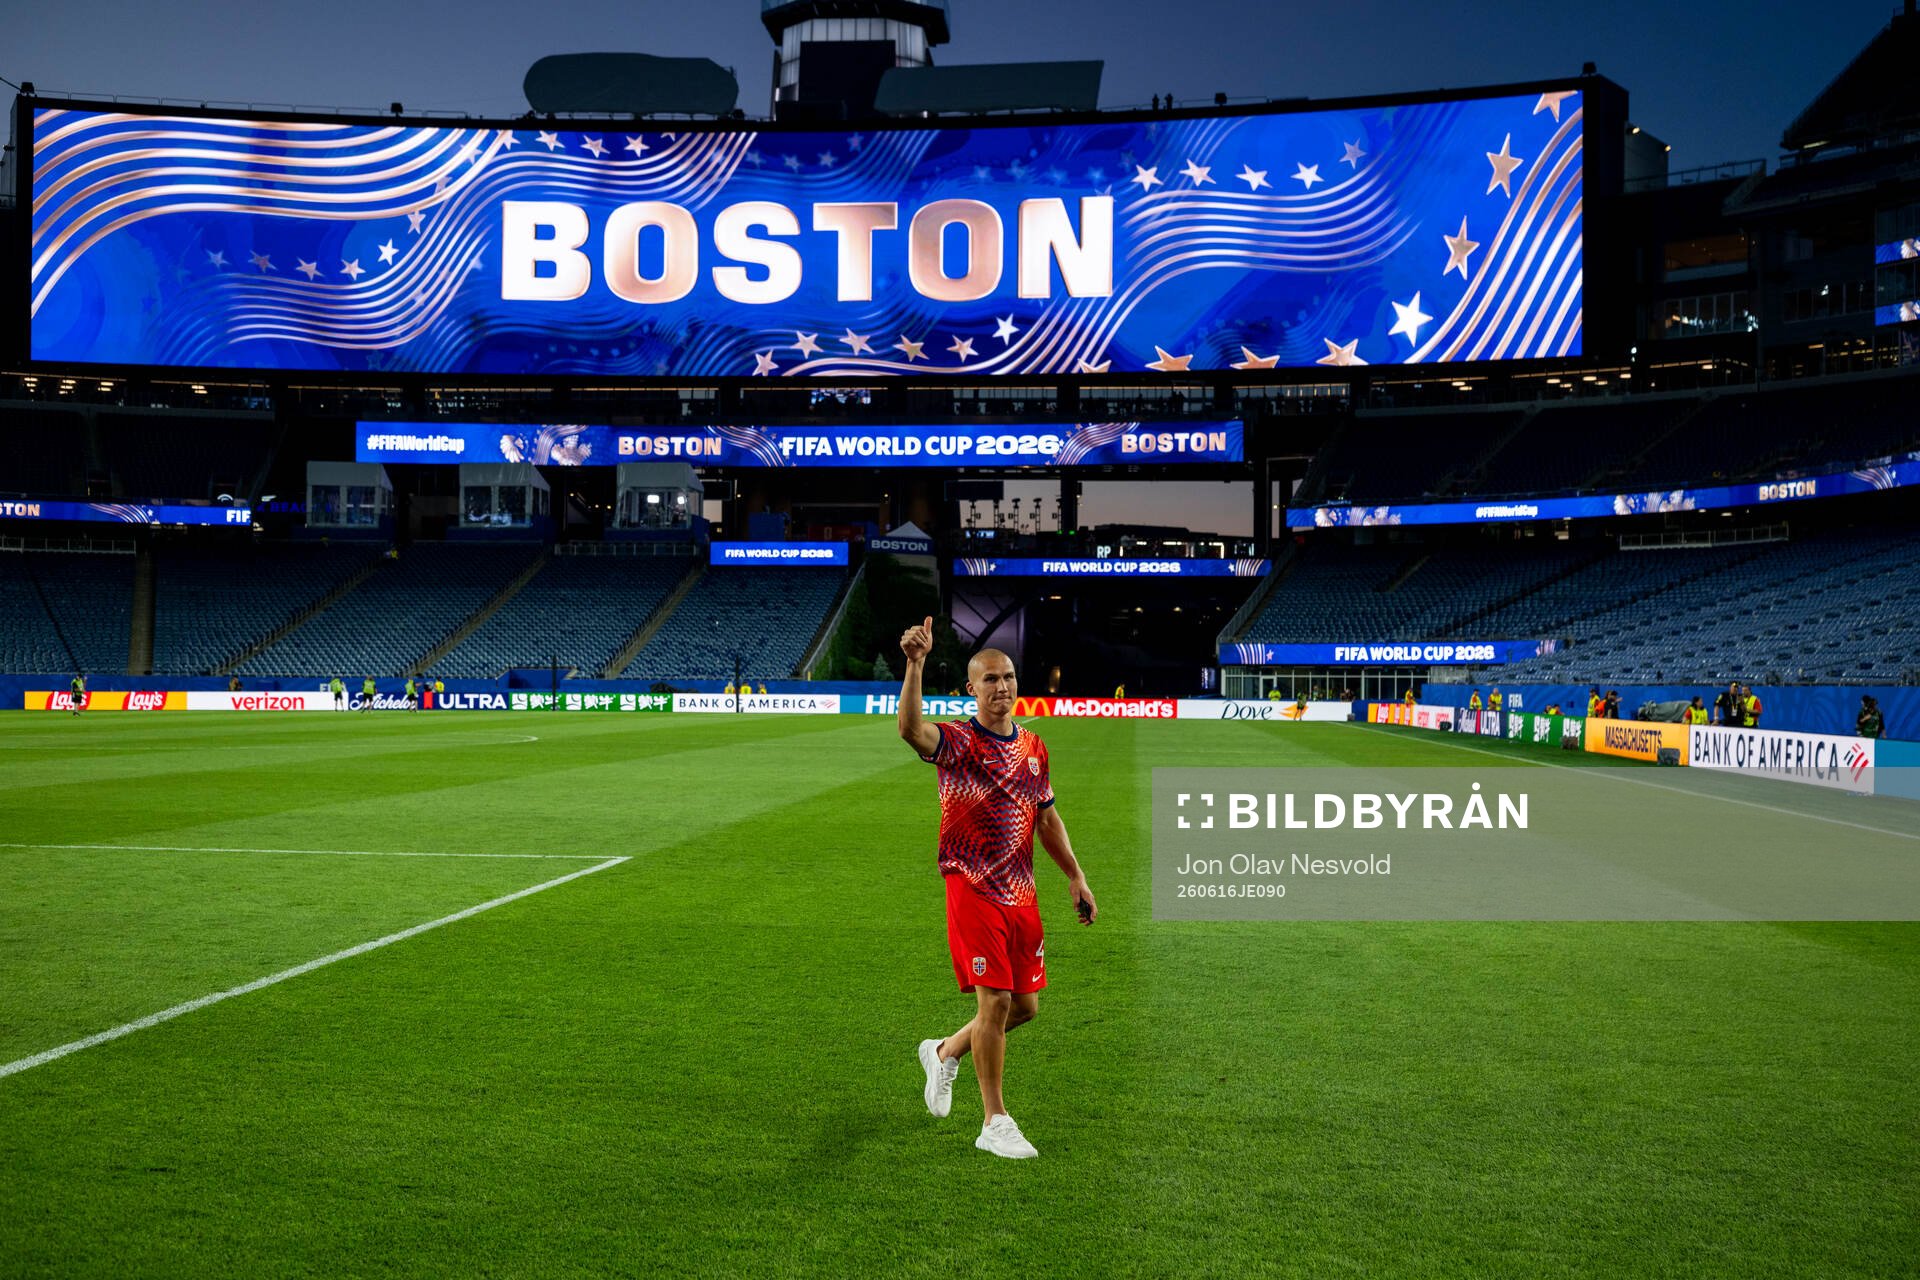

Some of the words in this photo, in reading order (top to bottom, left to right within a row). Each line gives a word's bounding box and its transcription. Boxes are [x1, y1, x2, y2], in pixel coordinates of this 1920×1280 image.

[501, 196, 1114, 303] BOSTON
[367, 434, 465, 454] #FIFAWorldCup
[618, 436, 722, 456] BOSTON
[782, 436, 836, 456] FIFA
[836, 436, 923, 456] WORLD
[925, 436, 972, 455] CUP
[975, 435, 1061, 455] 2026
[1121, 432, 1226, 453] BOSTON
[1759, 480, 1816, 500] BOSTON
[725, 549, 745, 558] FIFA
[746, 549, 780, 558] WORLD
[781, 549, 800, 558] CUP
[800, 549, 833, 558] 2026
[871, 539, 928, 551] BOSTON
[1042, 561, 1068, 573] FIFA
[1069, 561, 1111, 573] WORLD
[1113, 561, 1137, 573] CUP
[1138, 561, 1181, 573] 2026
[1335, 646, 1368, 661] FIFA
[1369, 646, 1421, 661] WORLD
[1423, 646, 1453, 660] CUP
[128, 691, 163, 710] Lay's
[231, 692, 304, 710] verizon
[439, 693, 507, 709] ULTRA
[679, 698, 719, 708] BANK
[725, 698, 743, 708] OF
[748, 698, 817, 709] AMERICA
[1053, 699, 1173, 718] McDonald's
[1221, 700, 1273, 720] Dove
[1508, 693, 1523, 708] FIFA
[1605, 725, 1662, 753] MASSACHUSETTS
[1694, 730, 1732, 766] BANK
[1736, 733, 1754, 769] OF
[1758, 736, 1840, 782] AMERICA
